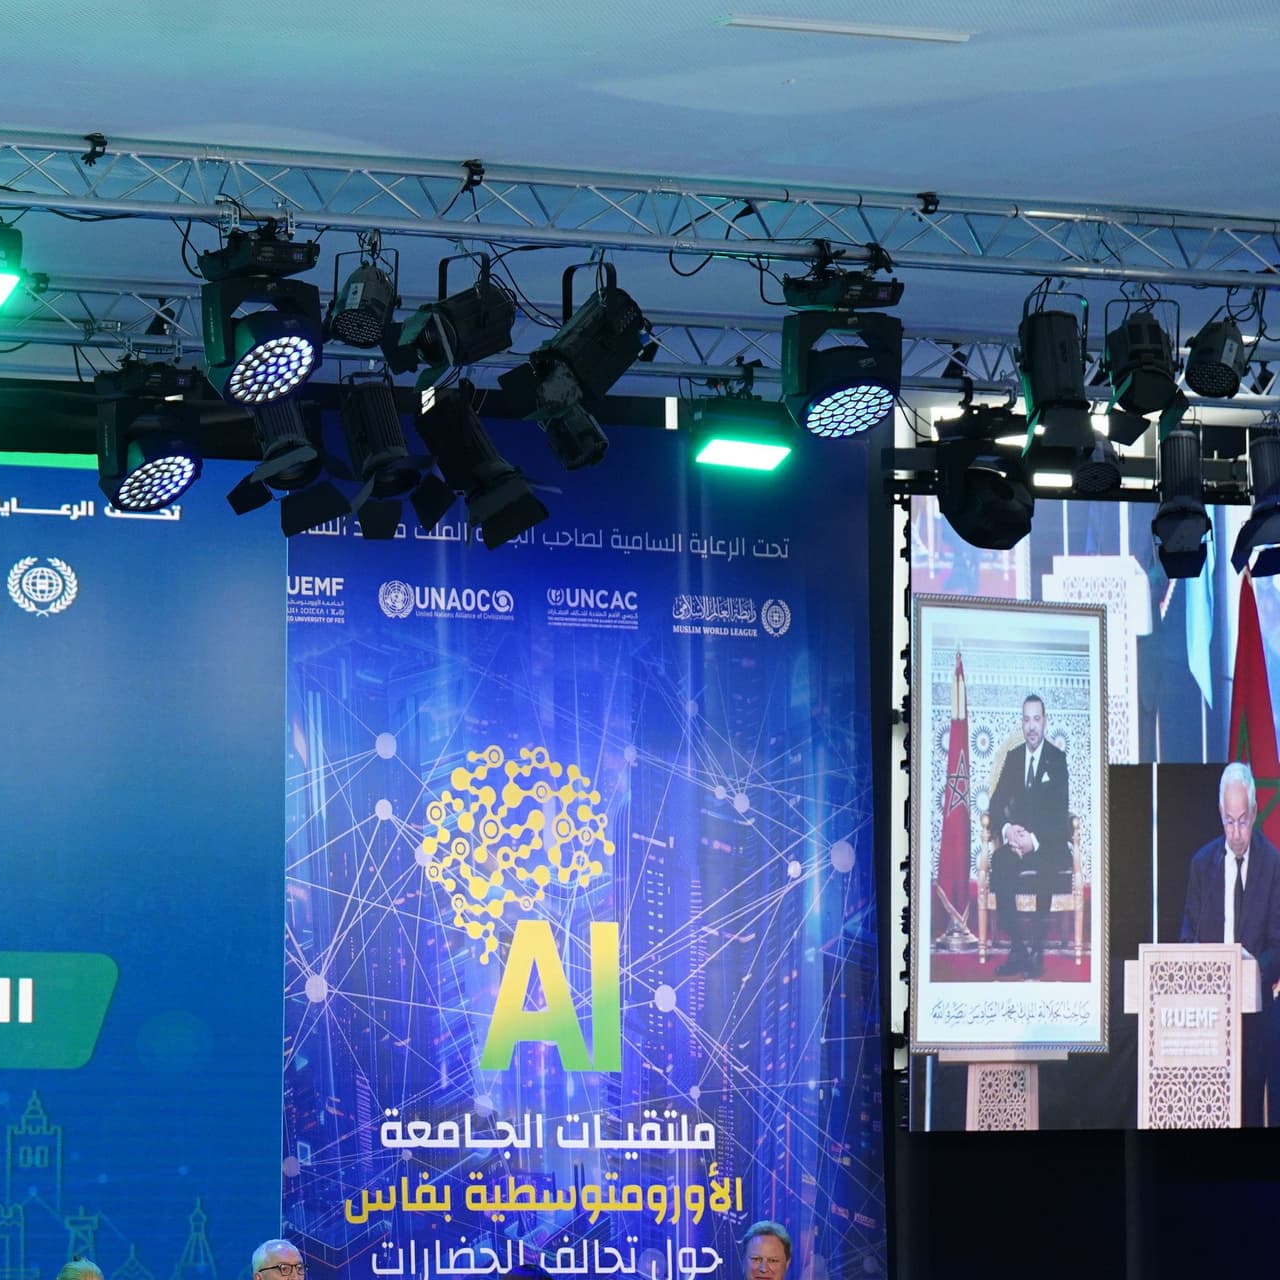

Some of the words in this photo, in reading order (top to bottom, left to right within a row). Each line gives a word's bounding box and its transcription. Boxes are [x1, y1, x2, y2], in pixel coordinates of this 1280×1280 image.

[542, 528, 602, 551] لصاحب
[610, 528, 682, 555] السامية
[690, 531, 745, 562] الرعاية
[752, 537, 790, 559] تحت
[287, 576, 344, 597] UEMF
[415, 587, 490, 613] UNAOC
[565, 588, 638, 610] UNCAC
[672, 624, 702, 635] MUSLIM
[702, 626, 729, 636] WORLD
[730, 627, 758, 638] LEAGUE
[479, 920, 622, 1073] AI
[380, 1107, 543, 1160] الجامعة
[556, 1109, 716, 1160] ملتقيات
[344, 1170, 452, 1225] بفاس
[540, 1235, 638, 1275] تحالف
